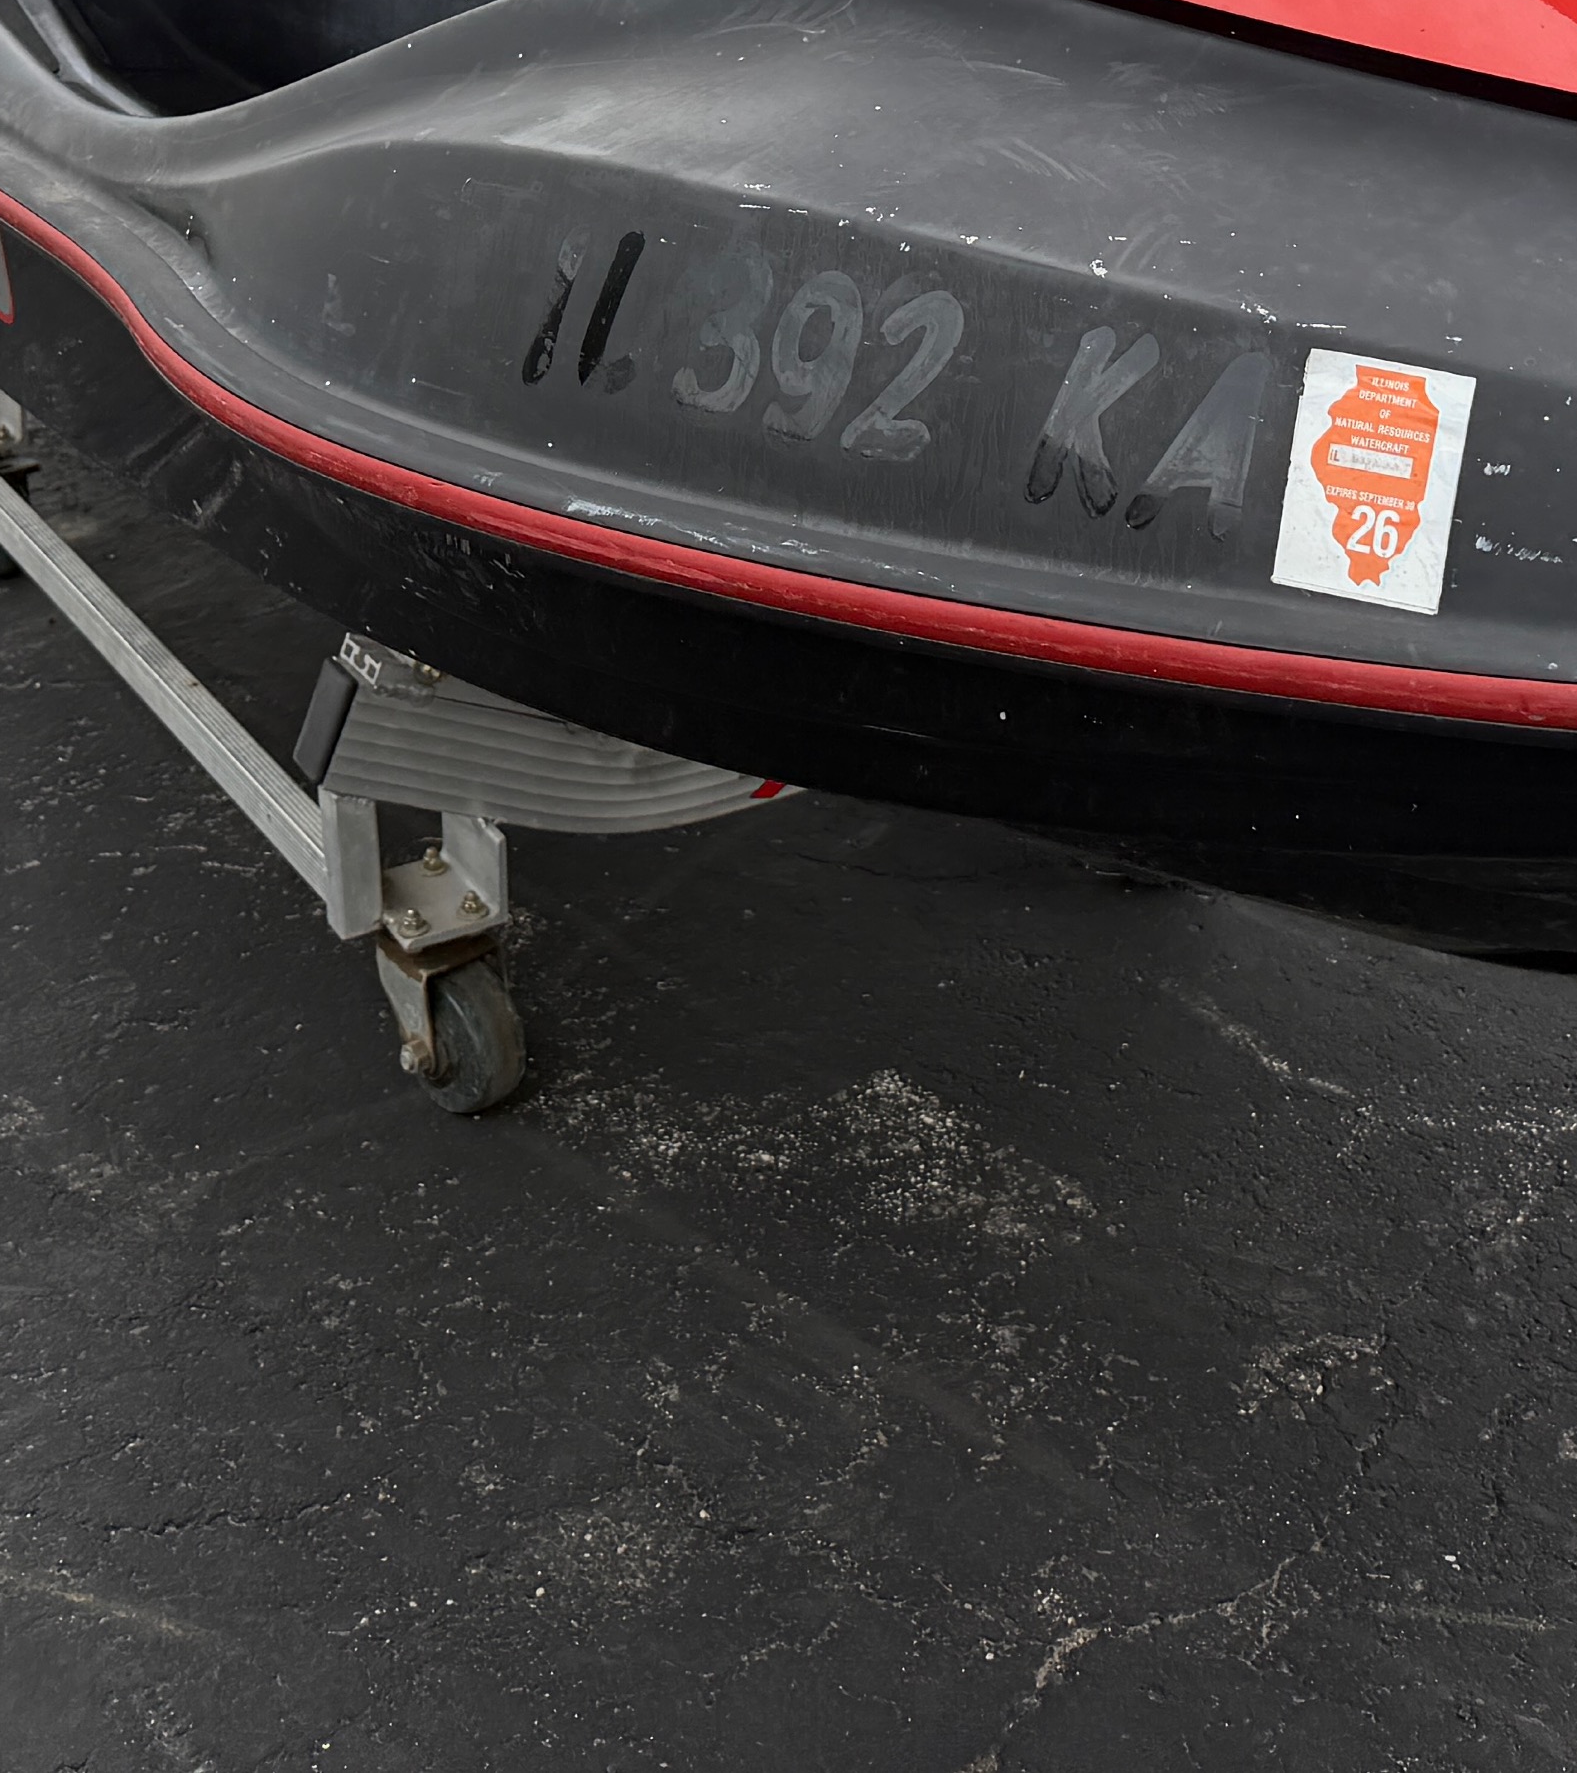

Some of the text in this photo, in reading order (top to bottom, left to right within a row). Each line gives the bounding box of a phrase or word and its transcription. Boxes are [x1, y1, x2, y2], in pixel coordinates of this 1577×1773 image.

[670, 235, 965, 463] 392
[1022, 325, 1271, 542] KA
[1371, 376, 1410, 392] ILLINOIS
[1358, 390, 1418, 409] DEPARTMENT
[1379, 409, 1391, 419] OF
[1334, 416, 1431, 444] NATURAL RESOURCES
[1350, 435, 1410, 454] WATERCRAFT
[1326, 485, 1357, 500] EXPIRES
[1359, 491, 1404, 509] SEPTEMBER
[1346, 504, 1401, 559] 26
